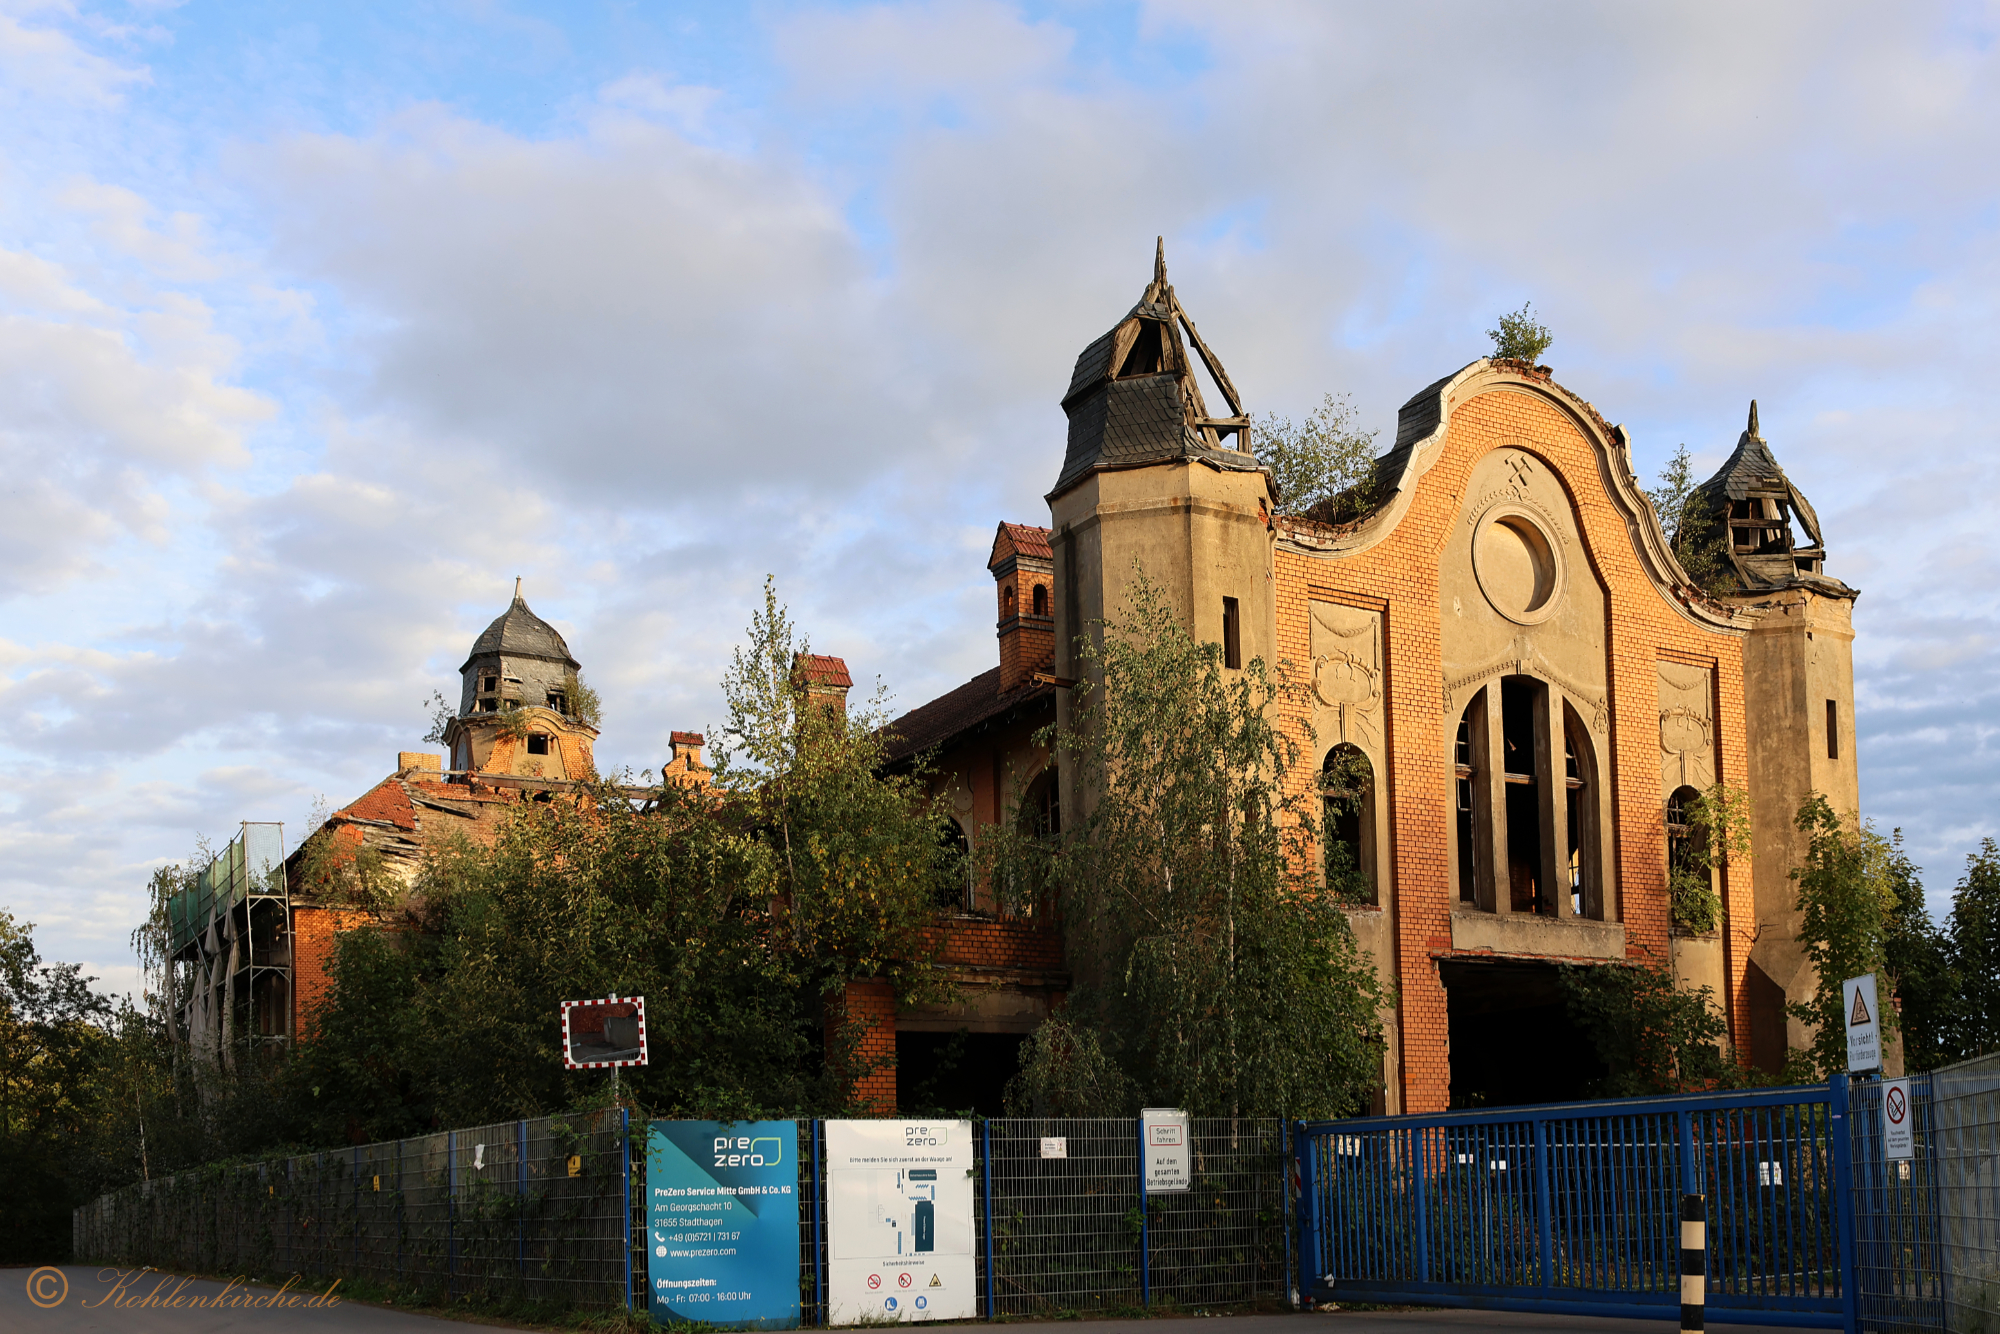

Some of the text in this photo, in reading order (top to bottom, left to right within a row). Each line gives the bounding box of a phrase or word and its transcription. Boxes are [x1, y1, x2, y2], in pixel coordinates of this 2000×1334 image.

[905, 1126, 928, 1137] pre
[1156, 1127, 1176, 1135] Schritt
[714, 1137, 750, 1153] pre
[906, 1137, 937, 1146] zero
[714, 1154, 764, 1167] zero
[1156, 1157, 1177, 1165] Auf dem
[1154, 1168, 1180, 1177] gesamten
[1147, 1178, 1187, 1187] Betriebsgelände
[654, 1185, 791, 1197] PreZero Service Mitte GmbH & Co. KG
[654, 1202, 732, 1213] Am Georgschacht 10
[654, 1217, 723, 1228] 31655 Stadthagen
[668, 1232, 684, 1243] +49
[684, 1232, 712, 1243] (0)5721
[717, 1231, 729, 1241] 731
[731, 1231, 740, 1240] 67
[669, 1247, 737, 1258] www.prezero.com
[656, 1277, 717, 1289] Öffnungszeiten:
[656, 1295, 669, 1304] Mo
[676, 1294, 686, 1303] Fr:
[688, 1292, 710, 1303] 07:00
[717, 1291, 737, 1302] 16:00
[738, 1291, 751, 1301] Uhr
